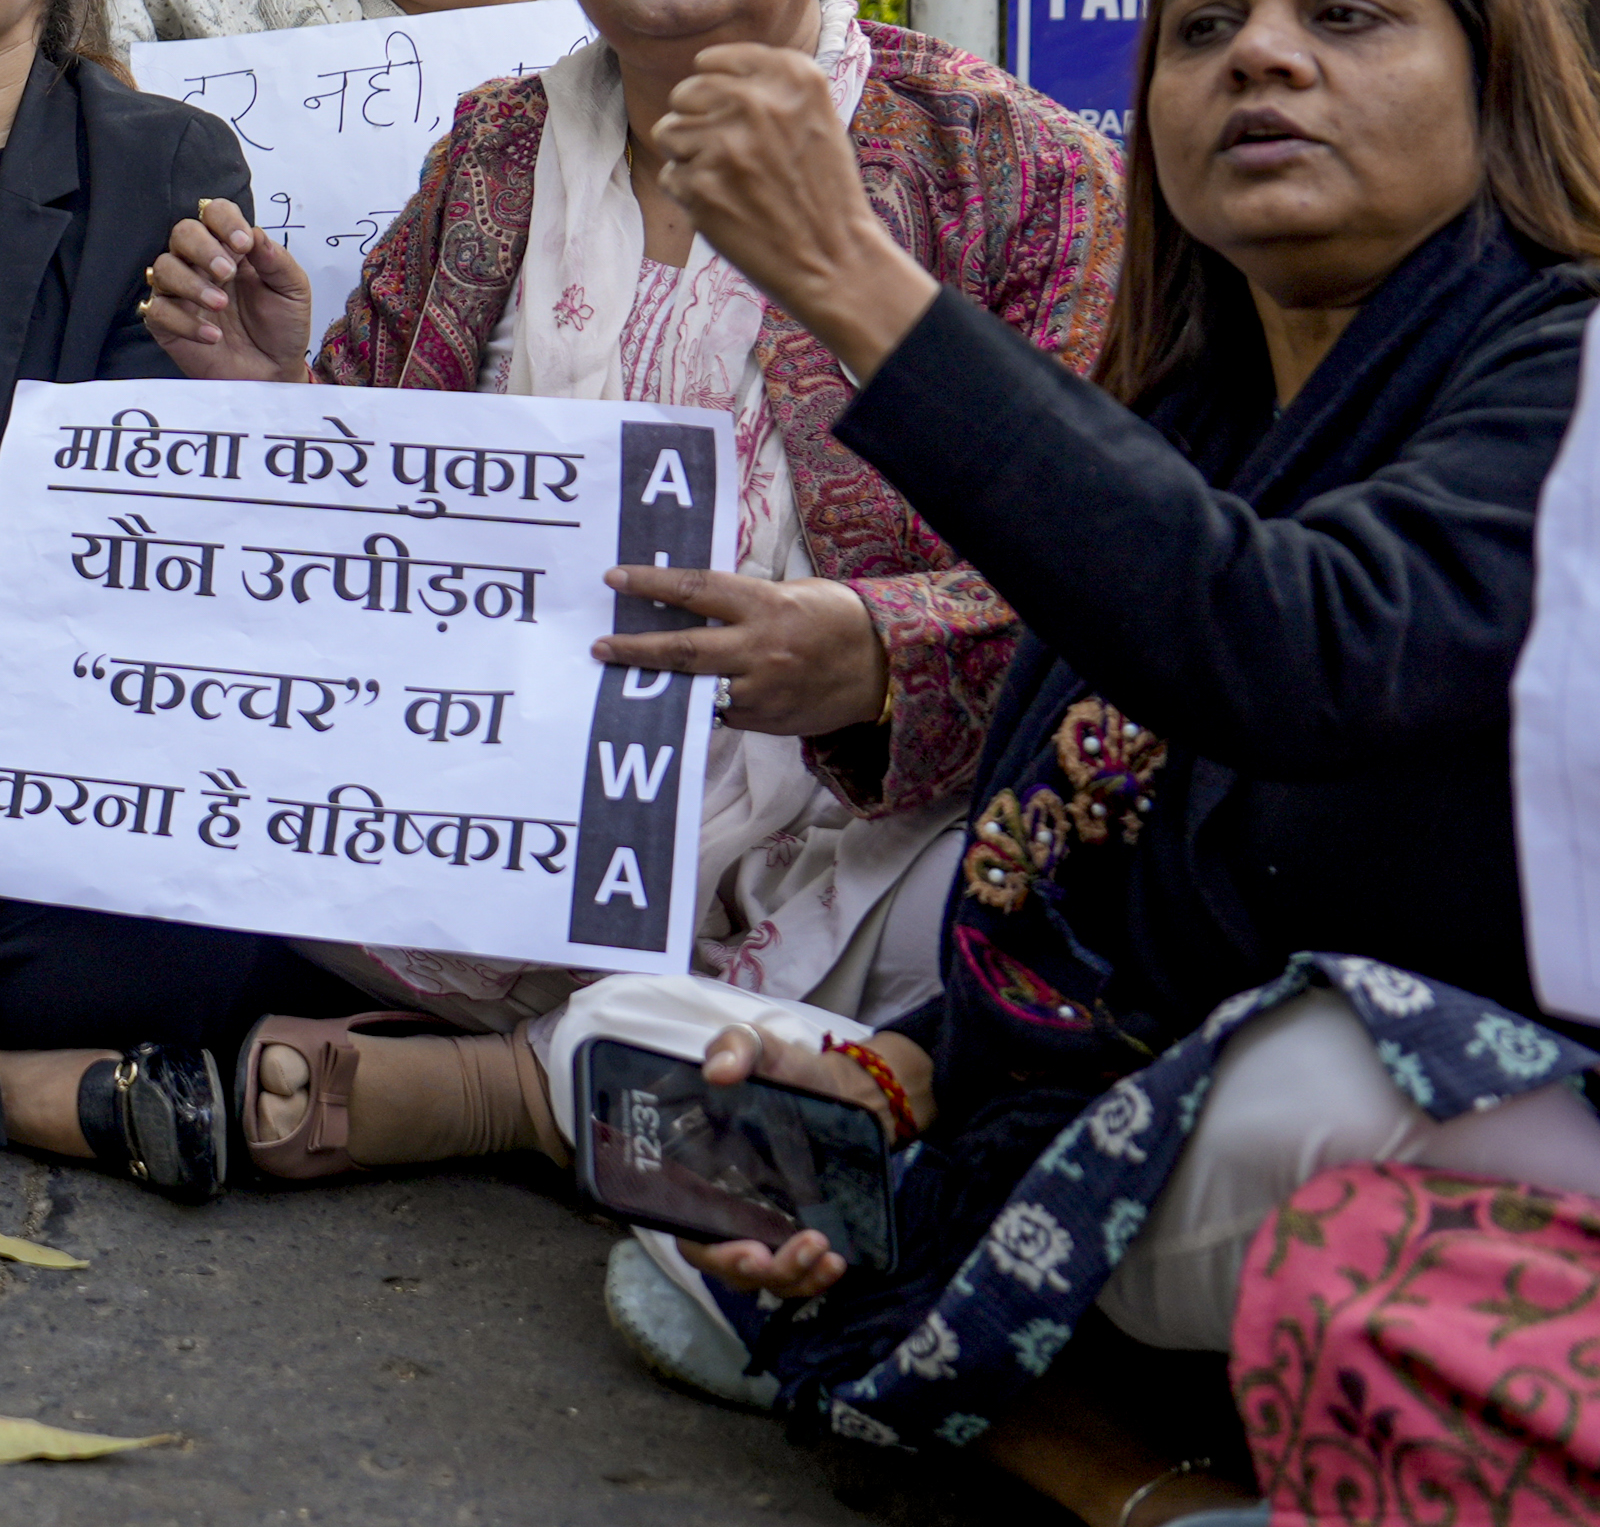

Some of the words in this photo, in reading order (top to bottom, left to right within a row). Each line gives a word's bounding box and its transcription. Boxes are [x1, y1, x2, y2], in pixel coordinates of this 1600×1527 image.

[53, 408, 249, 480] महिला
[263, 416, 375, 488] करे
[388, 441, 585, 519] पुकार
[70, 513, 225, 597] यौन
[240, 532, 546, 634] उत्पीड़न
[403, 685, 515, 746] का
[197, 768, 251, 850] है
[265, 783, 578, 875] बहिष्कार
[631, 1088, 662, 1174] 12:31
